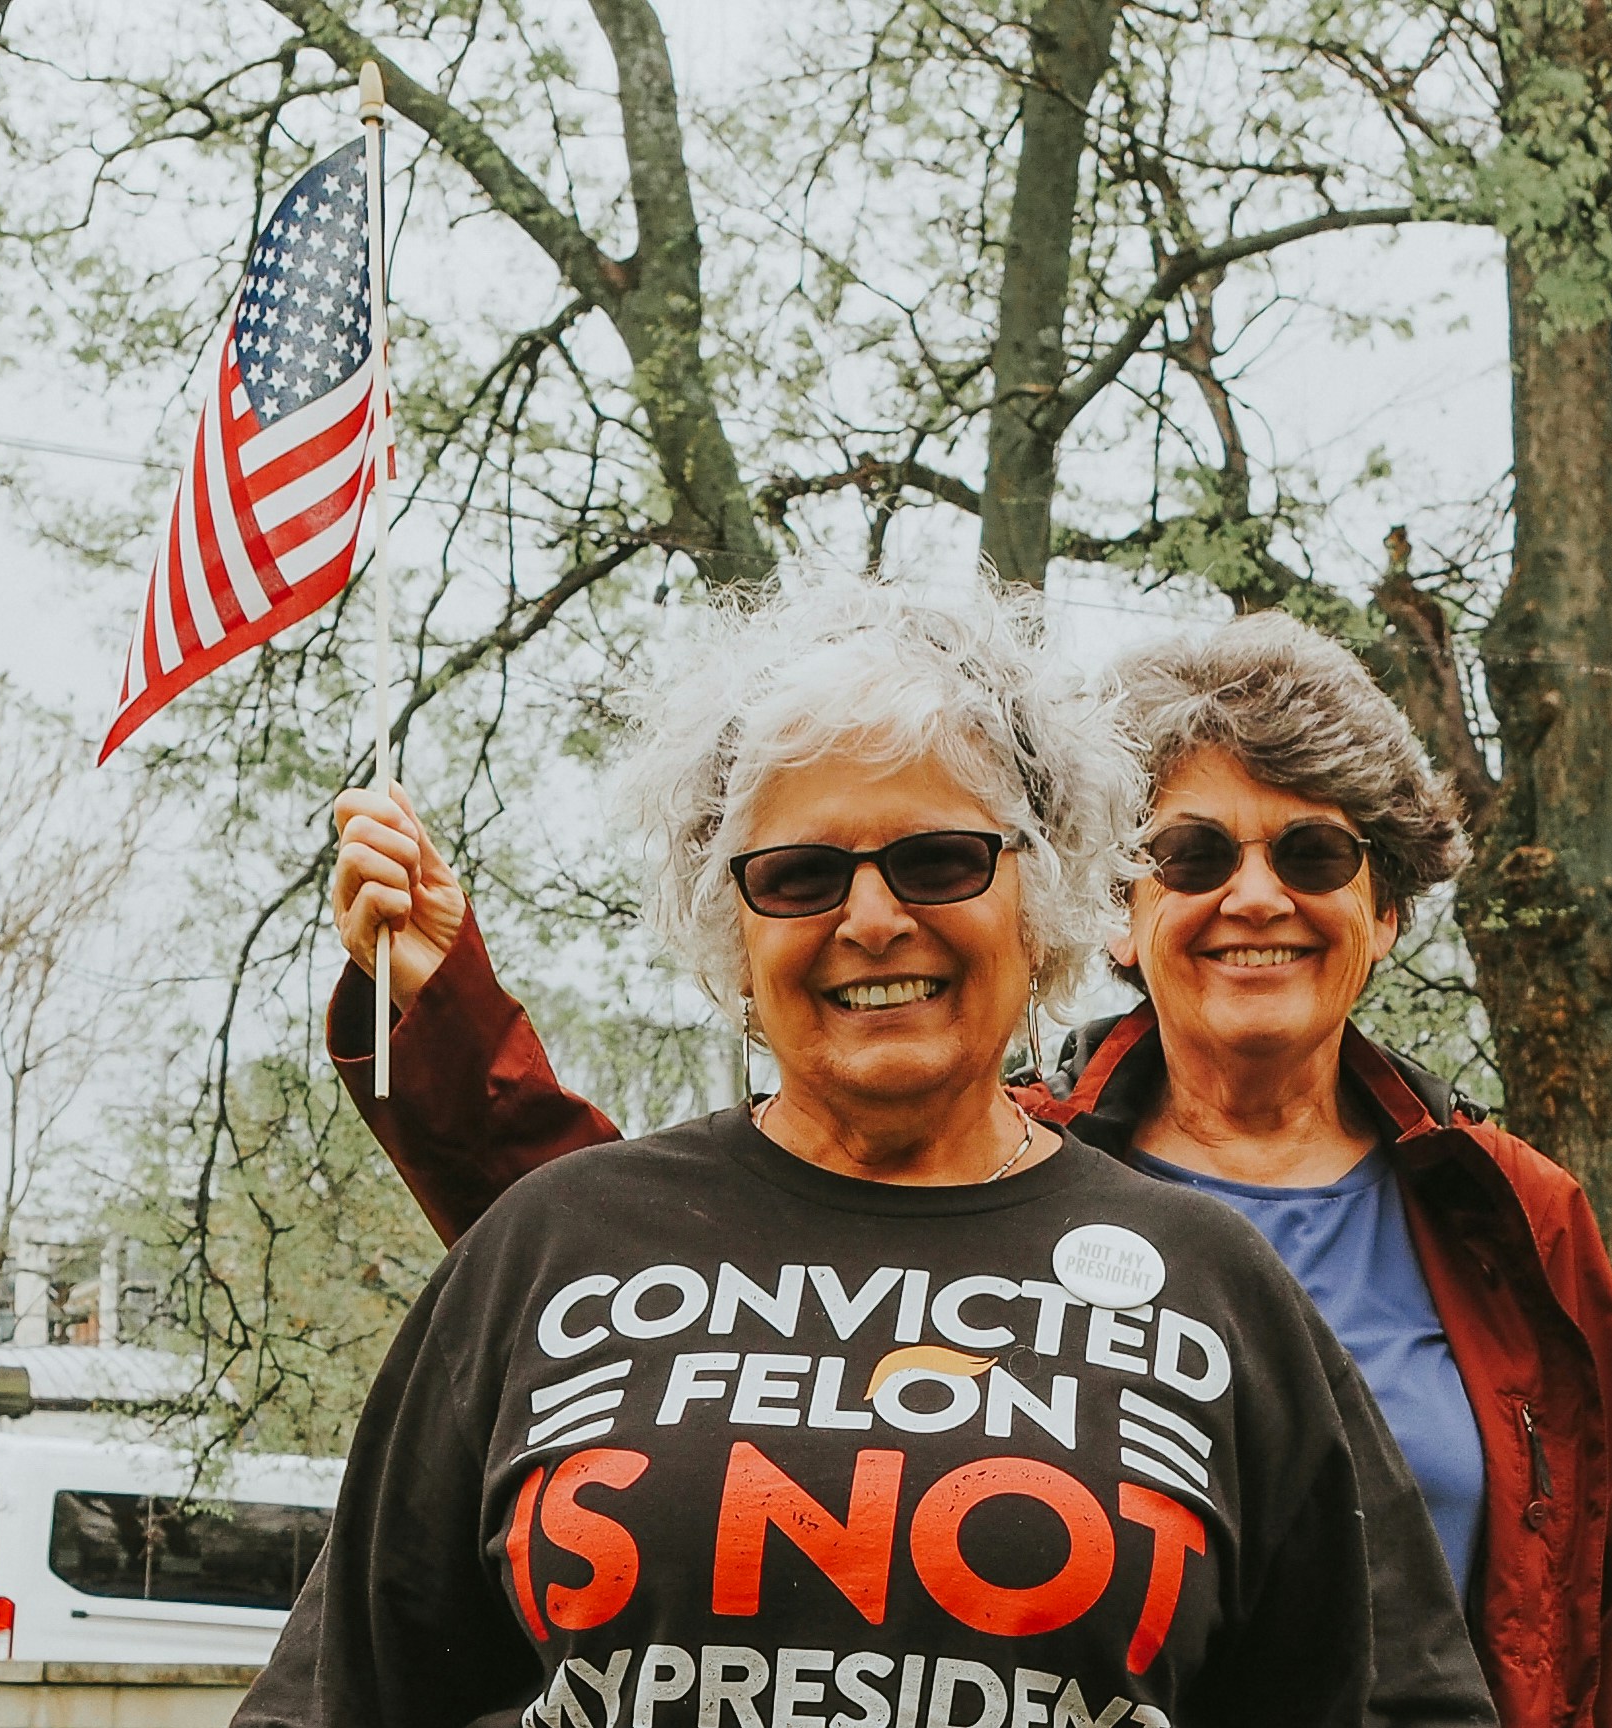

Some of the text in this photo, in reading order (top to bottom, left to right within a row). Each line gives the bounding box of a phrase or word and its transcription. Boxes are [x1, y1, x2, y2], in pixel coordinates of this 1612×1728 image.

[1065, 1255, 1154, 1292] PRESIDENT
[1078, 1241, 1146, 1269] NOT MY
[535, 1263, 1233, 1404] CONVICTED
[654, 1350, 1079, 1451] FELON
[505, 1441, 1208, 1675] IS NOT
